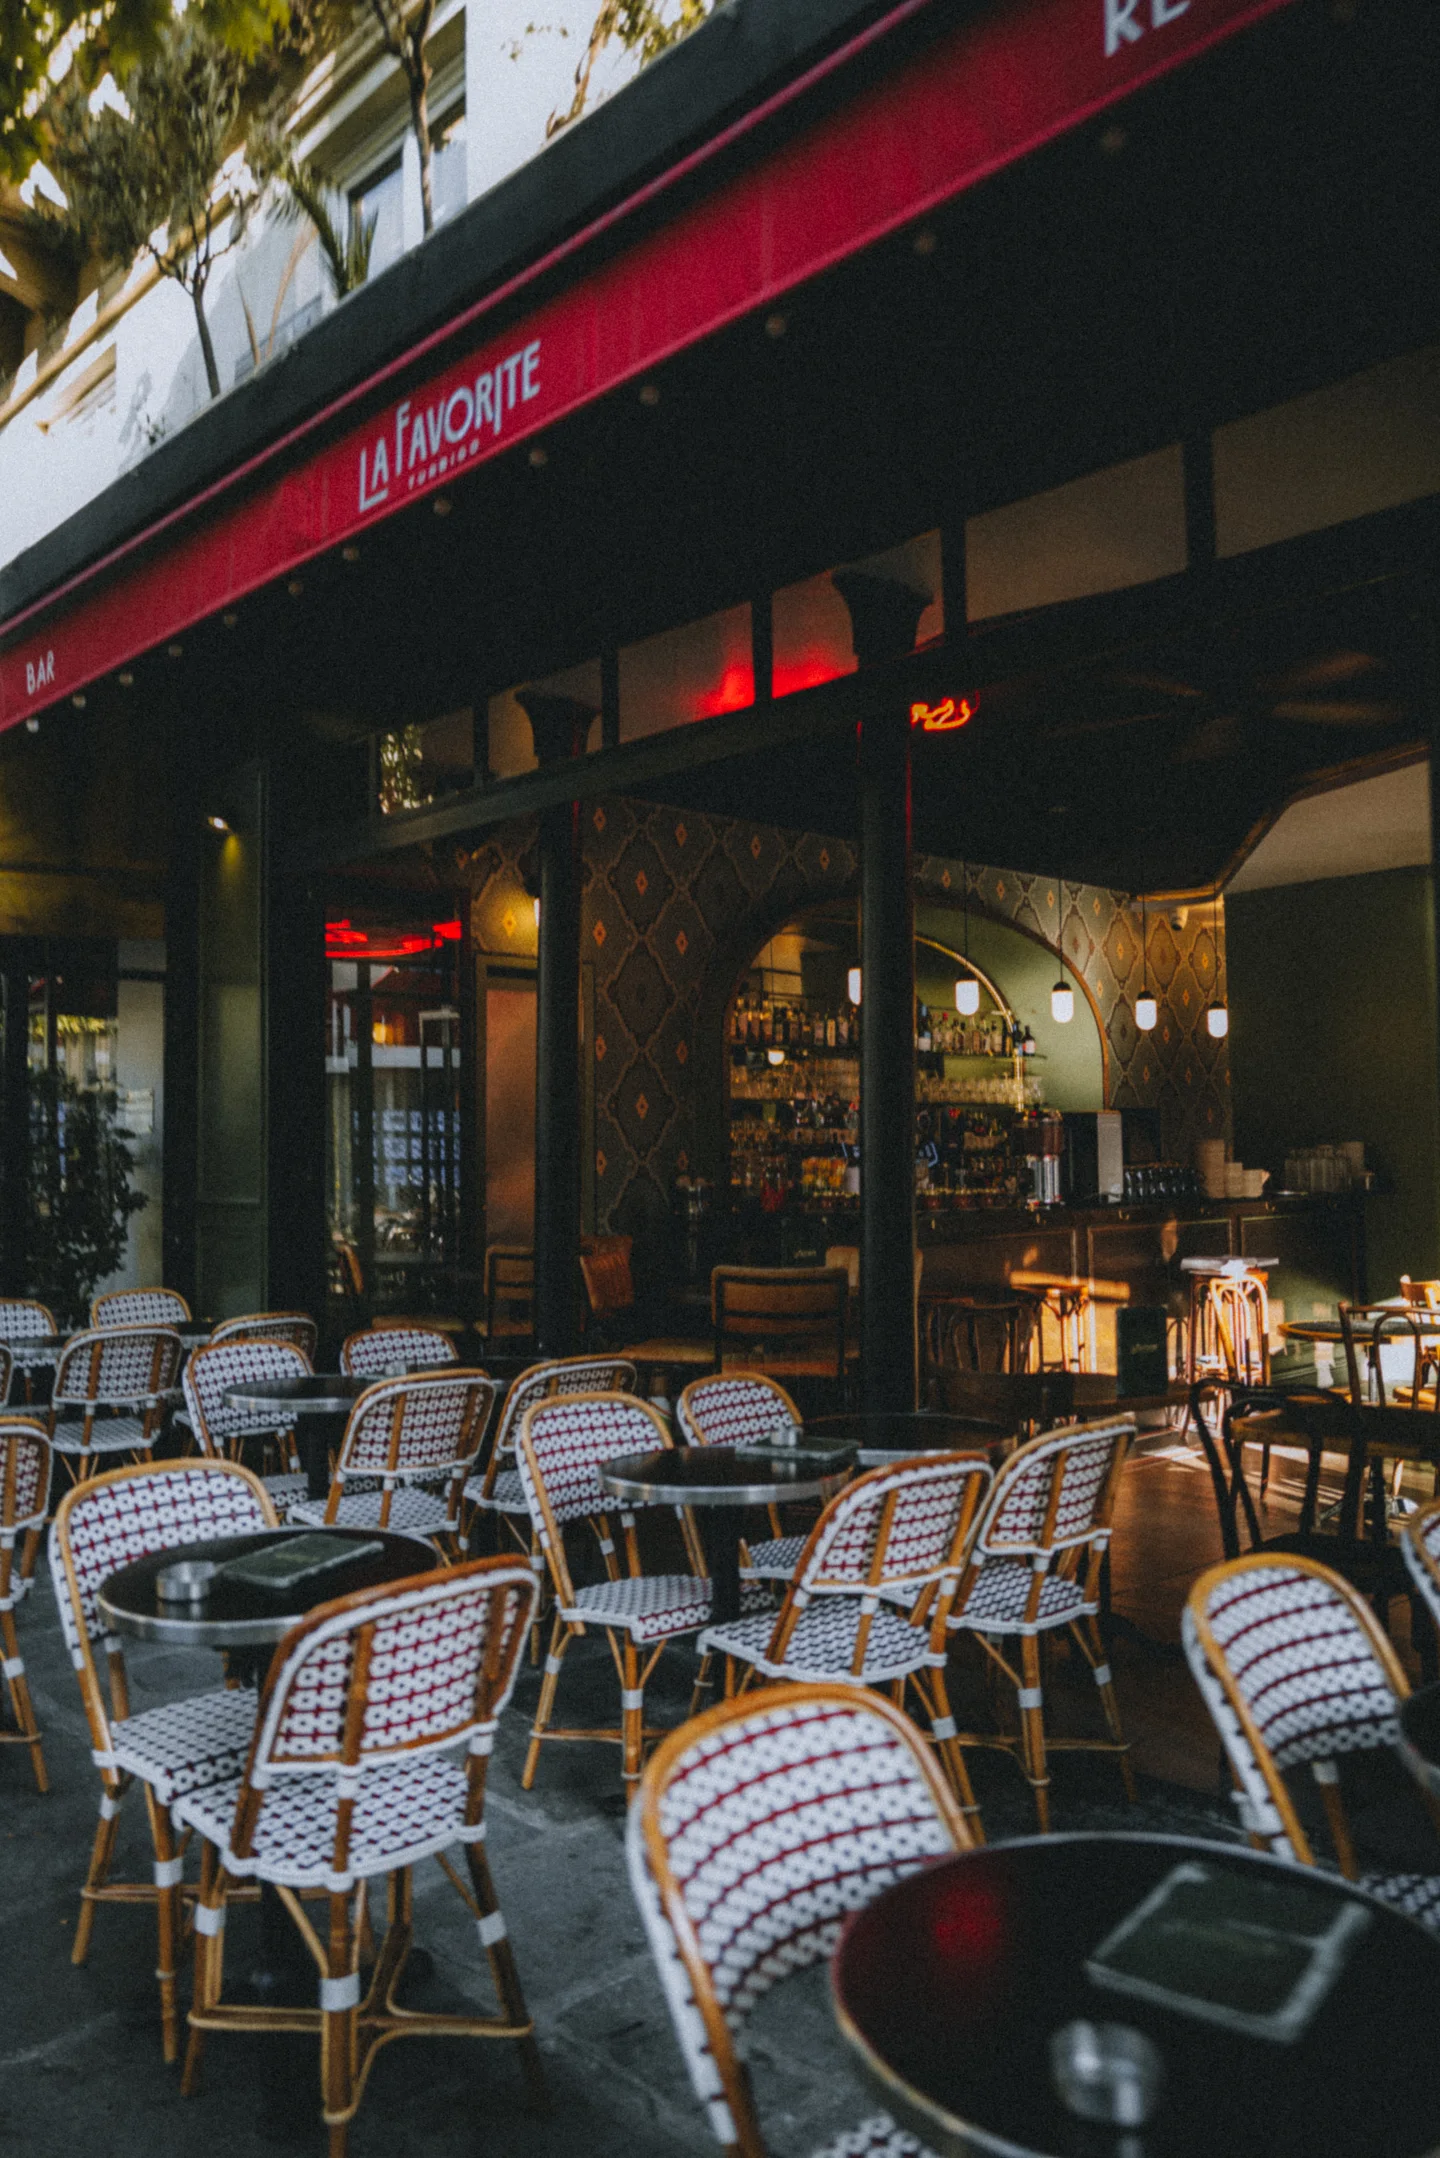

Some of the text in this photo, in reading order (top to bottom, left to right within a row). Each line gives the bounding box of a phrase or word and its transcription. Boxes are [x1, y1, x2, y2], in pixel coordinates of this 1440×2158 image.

[359, 437, 389, 513] LA
[395, 339, 542, 476] FAVORITE
[26, 649, 55, 696] BAR
